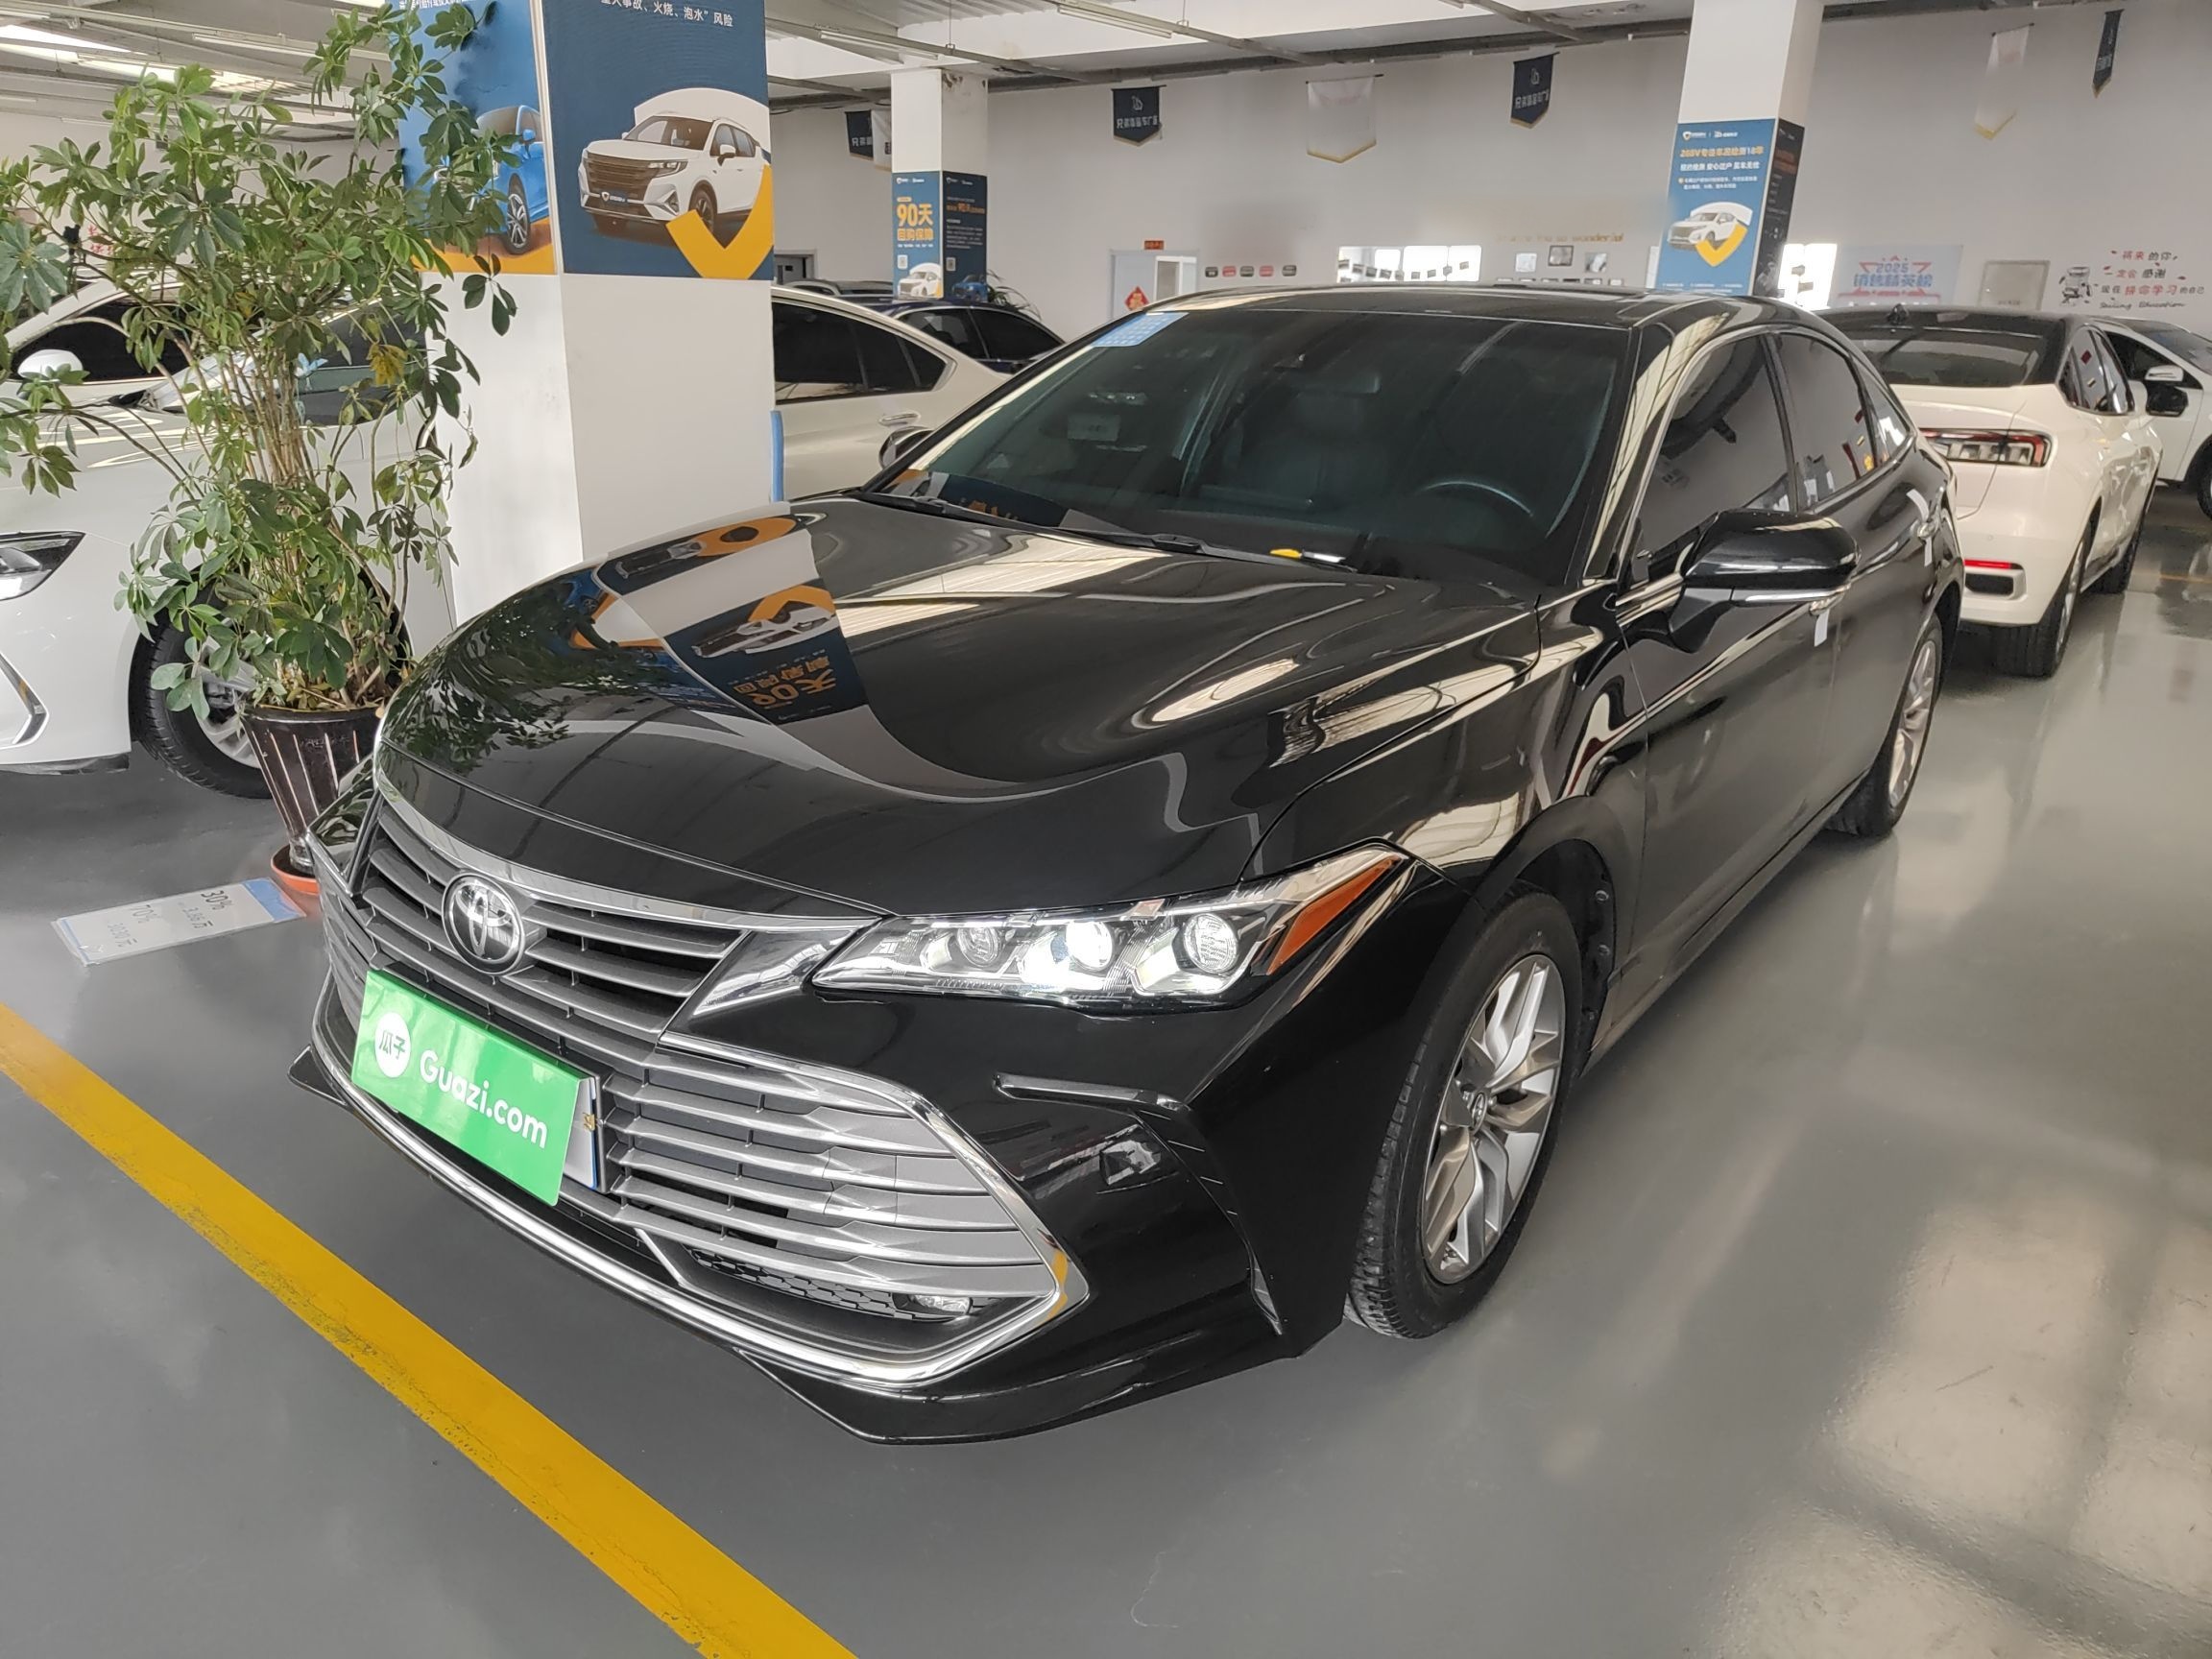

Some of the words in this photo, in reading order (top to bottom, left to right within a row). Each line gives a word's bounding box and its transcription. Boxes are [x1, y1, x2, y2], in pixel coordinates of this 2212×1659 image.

[897, 203, 934, 227] 90天
[1876, 262, 1910, 274] 2025
[201, 890, 235, 912] 30%
[378, 1029, 407, 1061] 瓜子
[419, 1048, 548, 1149] Guazi.com
